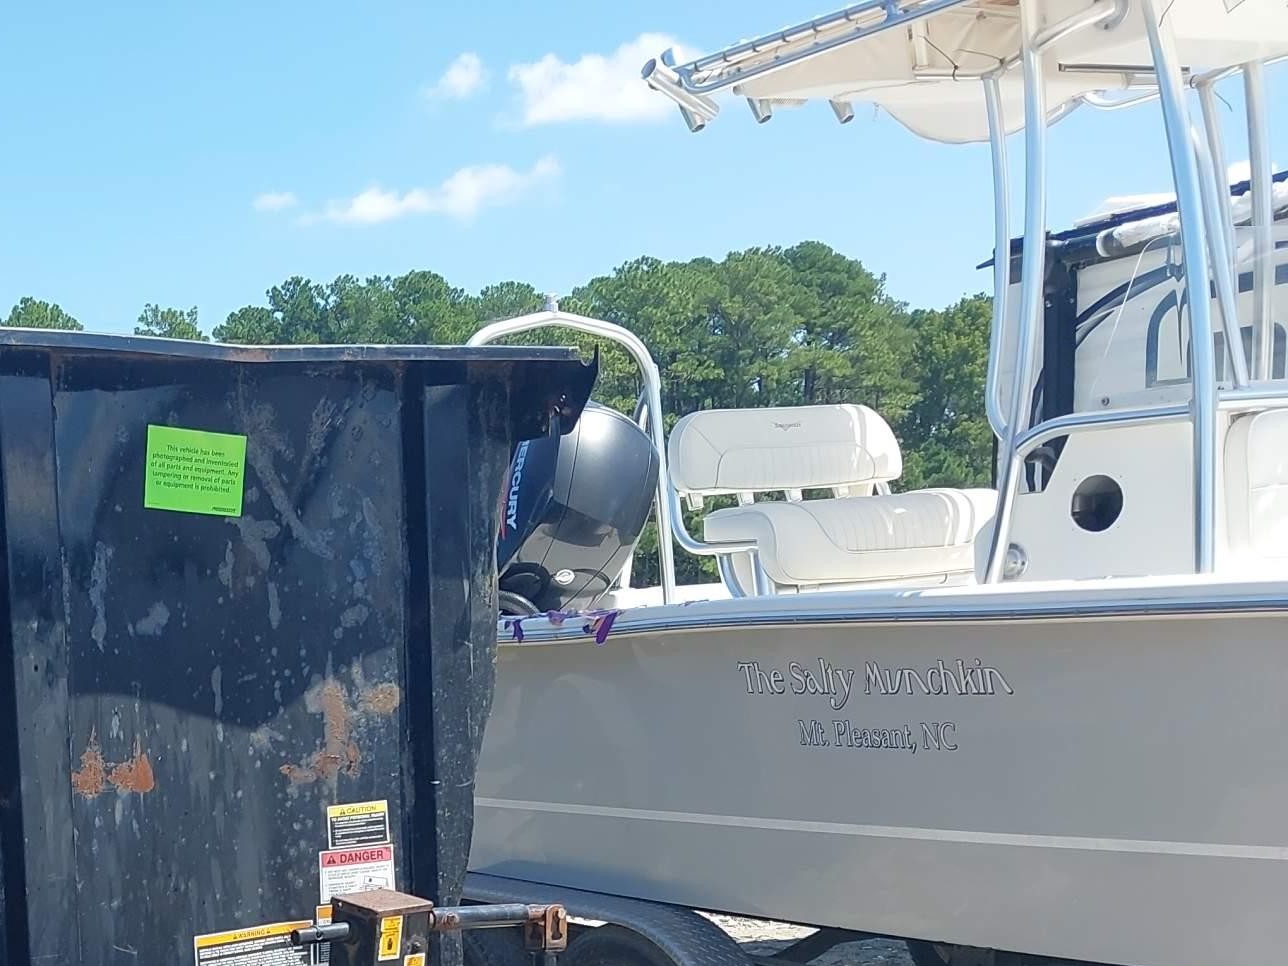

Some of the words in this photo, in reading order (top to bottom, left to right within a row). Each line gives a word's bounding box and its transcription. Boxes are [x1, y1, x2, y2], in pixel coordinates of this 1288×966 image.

[167, 444, 178, 452] This
[180, 446, 199, 455] vehicle
[200, 448, 210, 456] has
[212, 449, 225, 457] been
[152, 452, 193, 463] photographed
[206, 459, 239, 468] inventoried
[167, 462, 181, 471] parts
[228, 469, 239, 478] Any
[152, 470, 182, 480] tampering
[190, 475, 212, 483] removal
[221, 478, 236, 486] parts
[163, 480, 193, 489] equipment
[737, 661, 785, 695] The
[788, 657, 855, 710] Salty
[863, 658, 1014, 695] Munchkin
[798, 719, 830, 747] Mt.
[832, 719, 918, 754] Pleasant,
[920, 722, 958, 751] NC
[346, 805, 377, 814] CAUTION
[340, 850, 384, 863] DANGER
[238, 929, 265, 939] WARNING
